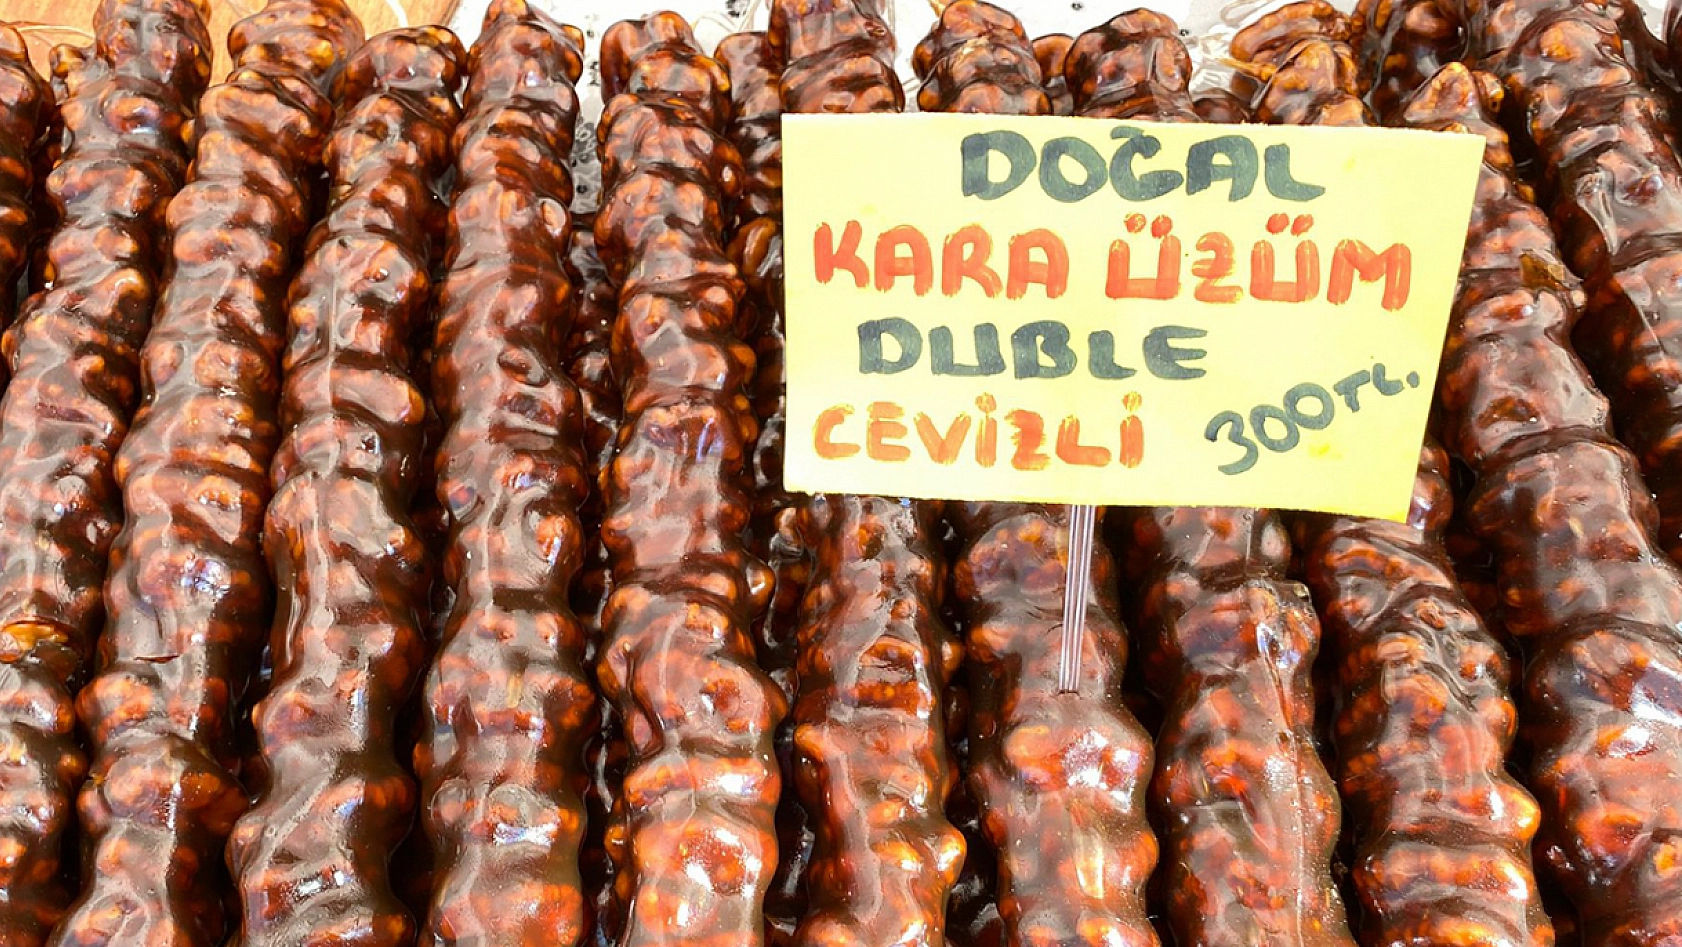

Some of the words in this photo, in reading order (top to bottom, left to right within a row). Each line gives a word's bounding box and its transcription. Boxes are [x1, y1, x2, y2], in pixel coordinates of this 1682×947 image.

[960, 127, 1326, 203] DOĞAL
[814, 220, 1070, 301] KARA
[1105, 212, 1412, 311] ÜZÜM
[857, 316, 1208, 381] DUBLE
[814, 391, 1145, 469] CEVİZLİ
